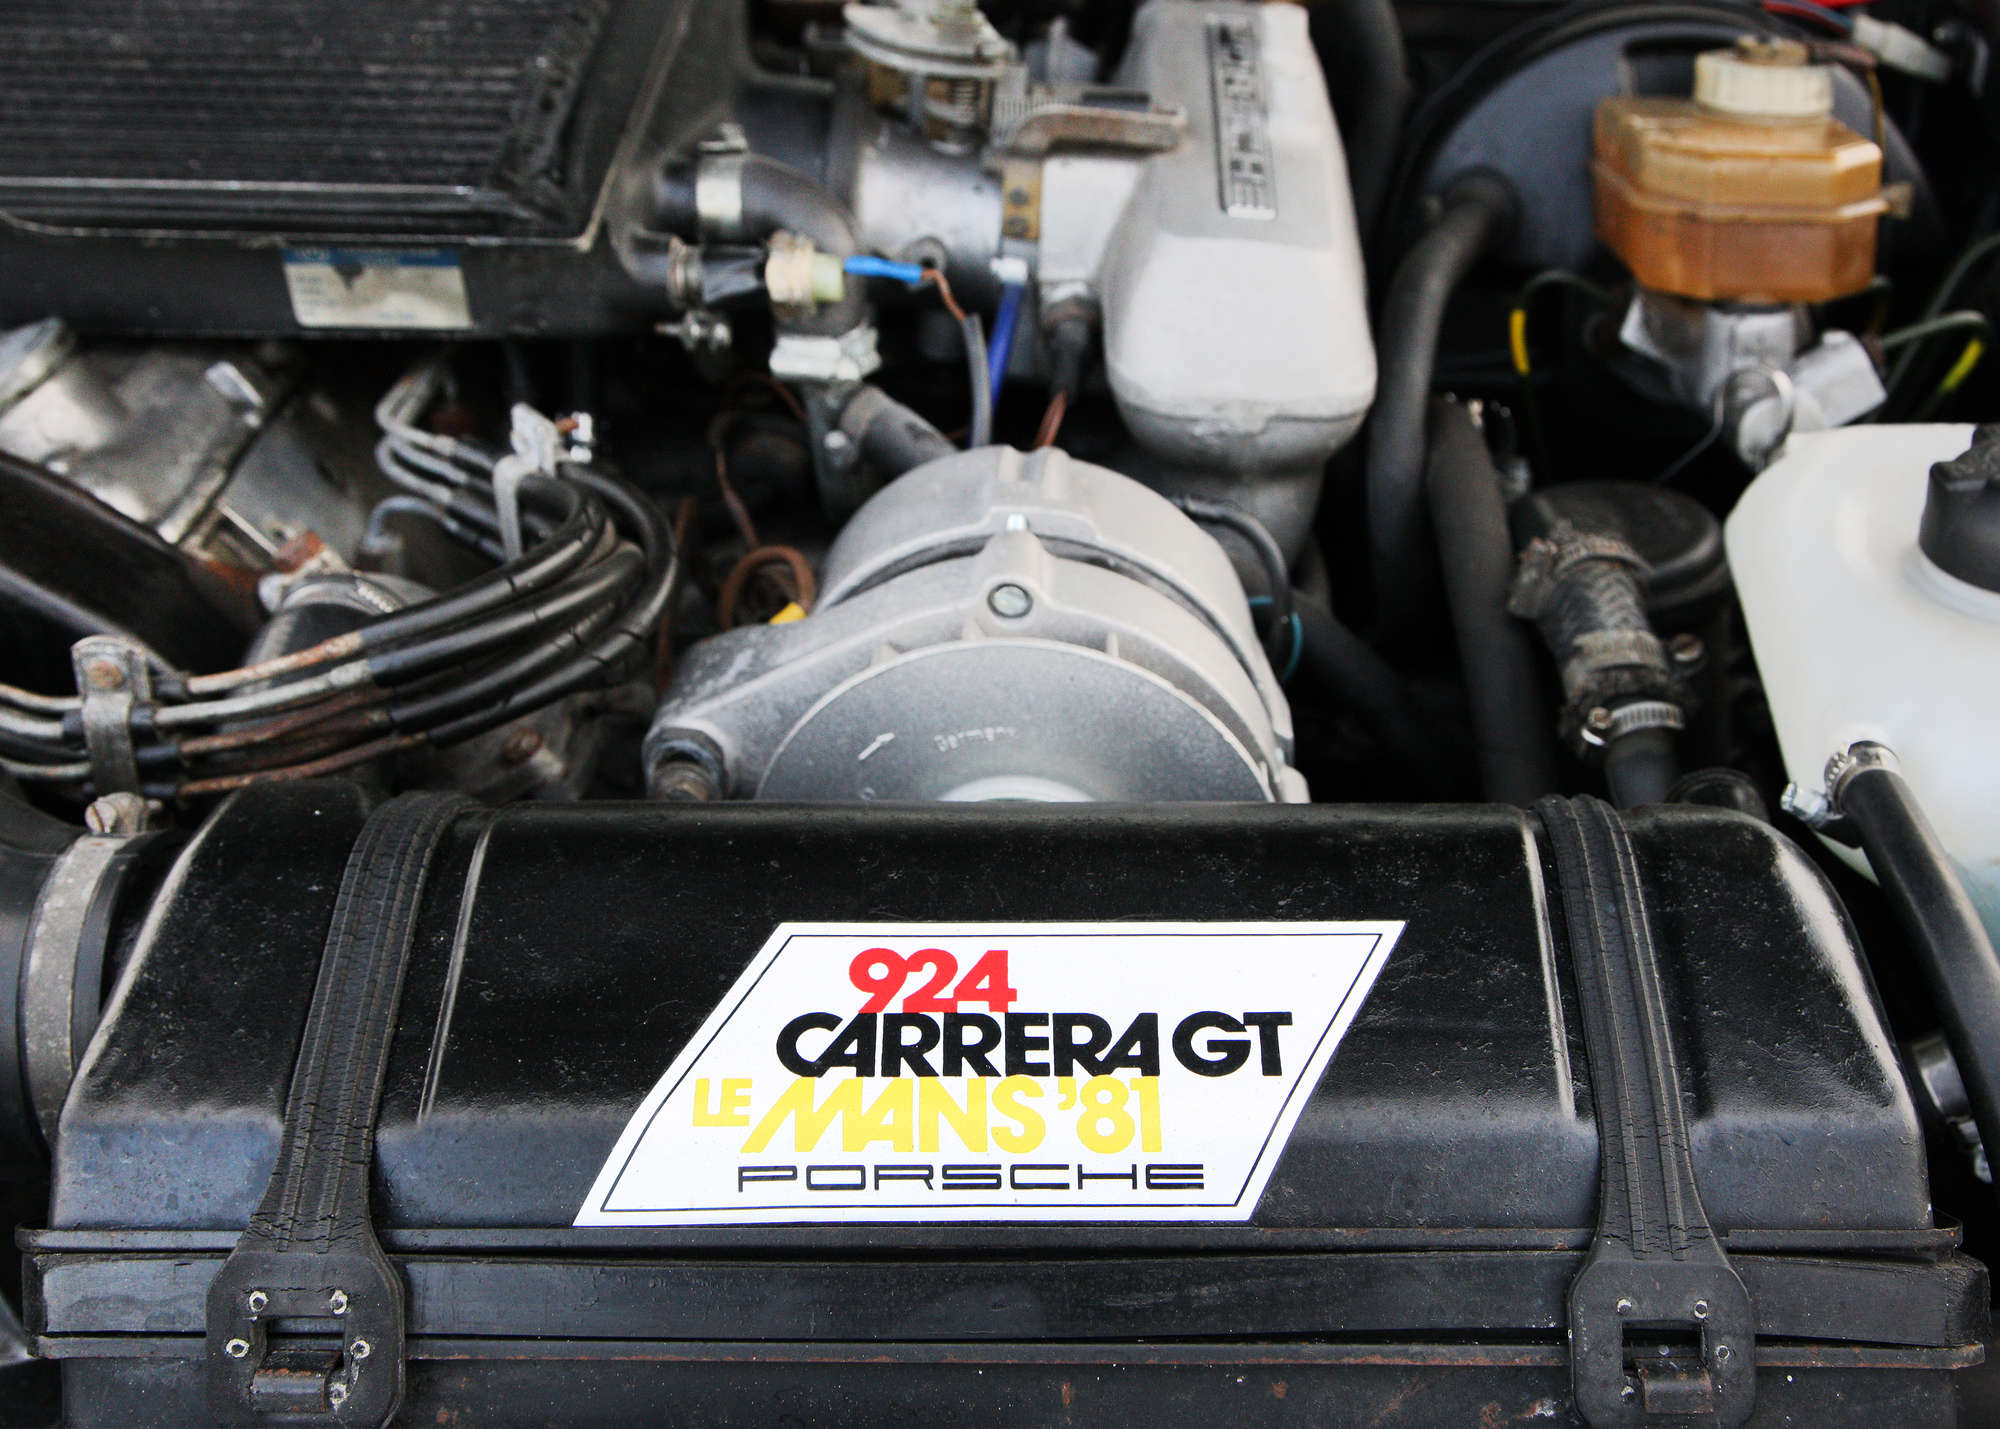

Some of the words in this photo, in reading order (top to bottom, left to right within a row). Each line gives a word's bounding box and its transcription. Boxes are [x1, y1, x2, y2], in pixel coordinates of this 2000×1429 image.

[848, 948, 1018, 1014] 924
[776, 1012, 1161, 1077] CARRERA
[1172, 1012, 1293, 1077] GT
[692, 1078, 754, 1127] LE
[740, 1075, 1047, 1154] MANS
[1058, 1075, 1163, 1154] '81
[738, 1165, 1205, 1192] PORSCHE
